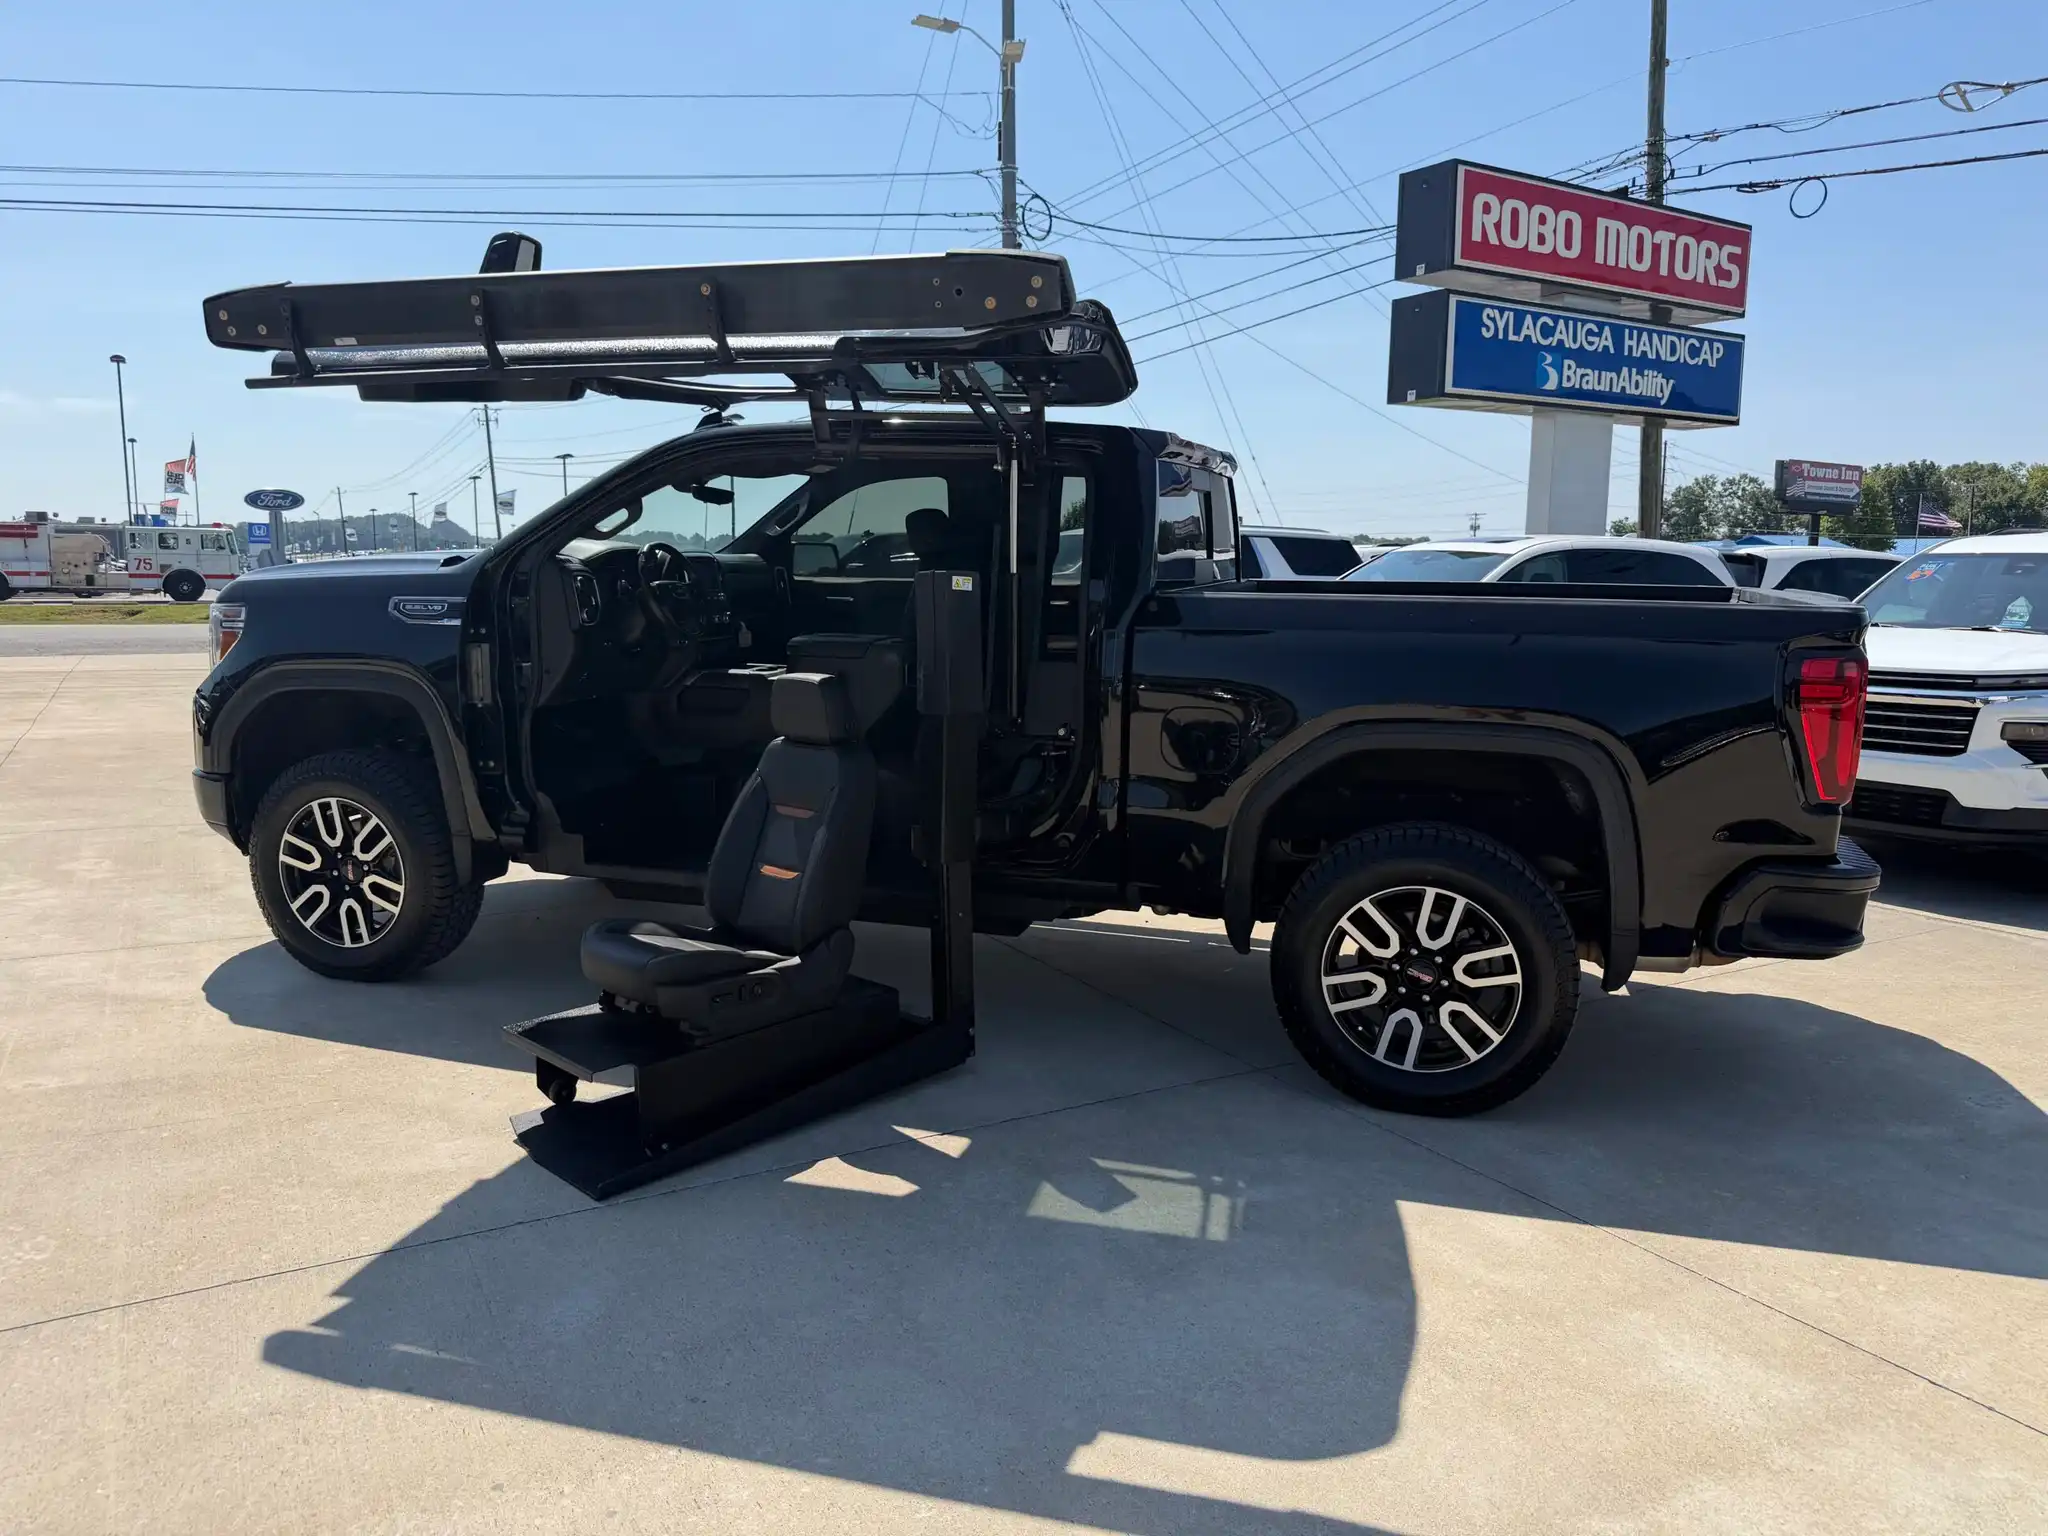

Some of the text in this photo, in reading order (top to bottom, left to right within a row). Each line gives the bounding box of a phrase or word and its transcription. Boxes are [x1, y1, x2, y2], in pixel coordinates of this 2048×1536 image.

[1471, 193, 1742, 289] ROBO MOTORS
[1480, 307, 1724, 368] SYLACAUGA HANDICAP
[1561, 358, 1674, 405] BraunAbility
[1802, 463, 1859, 481] Towne Inn
[257, 493, 292, 507] Ford
[134, 557, 153, 571] 75
